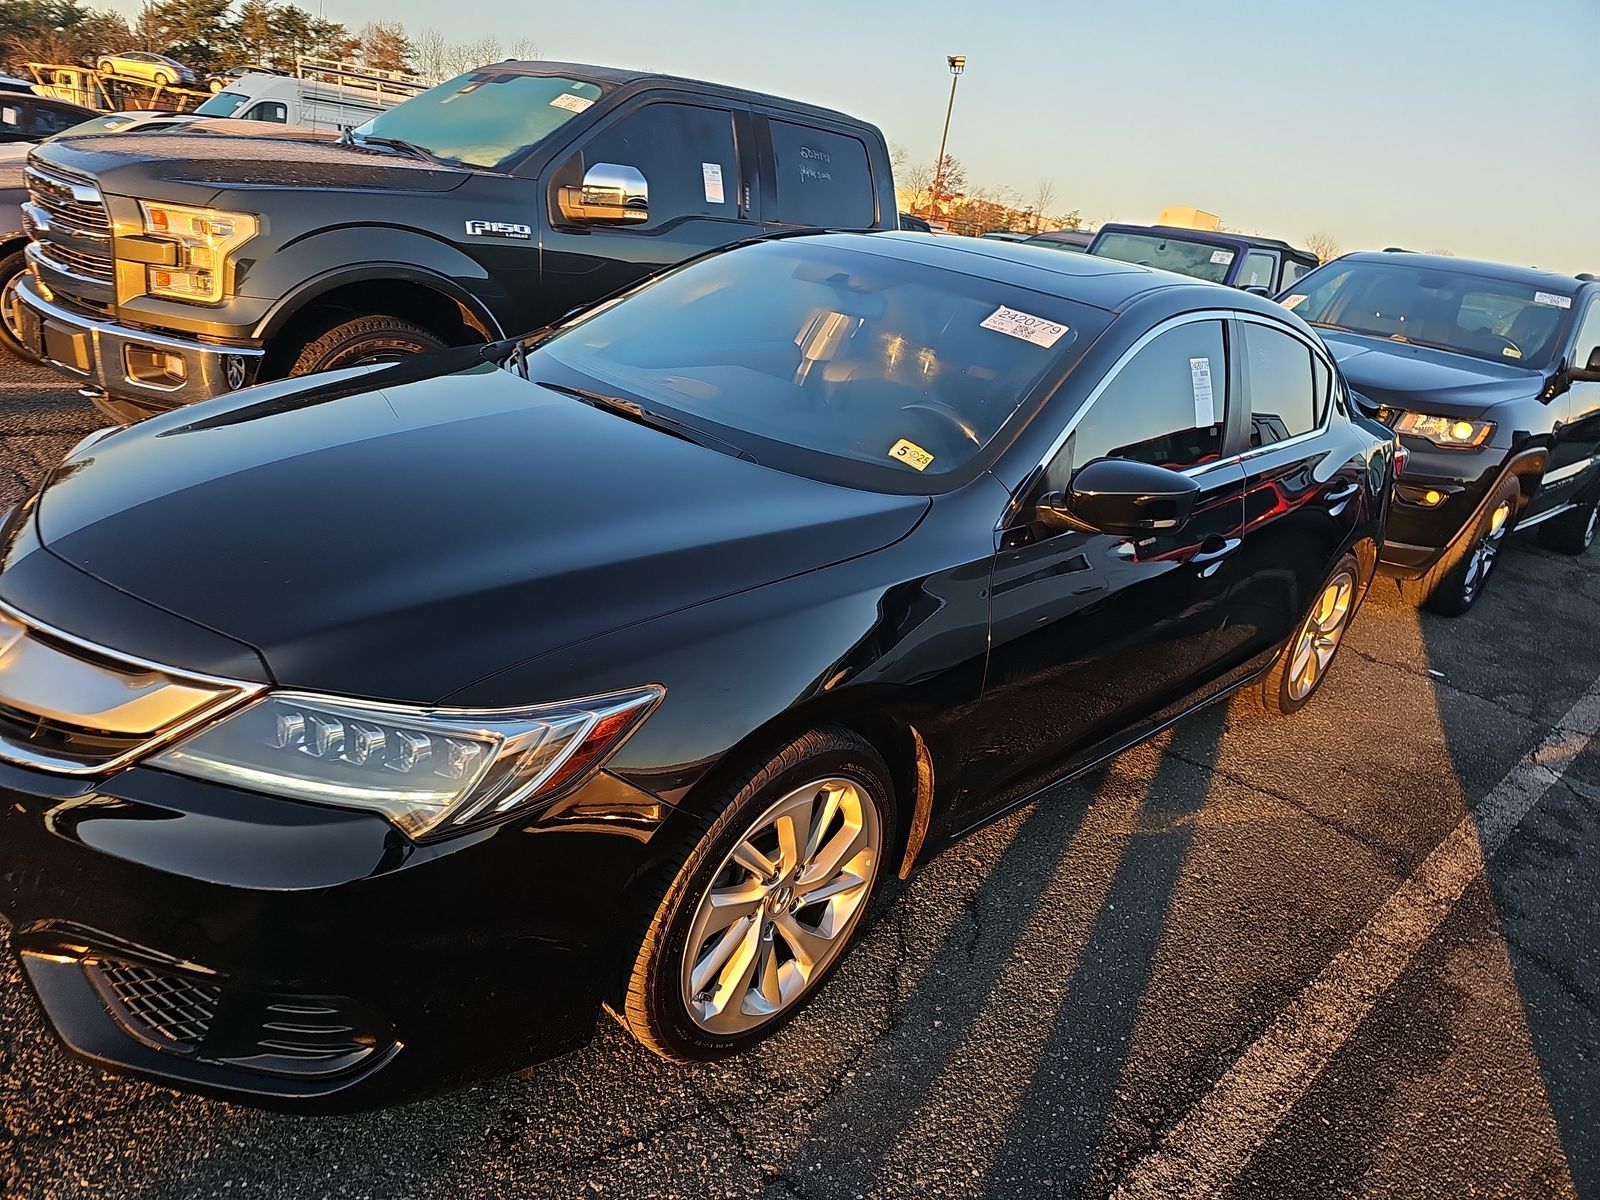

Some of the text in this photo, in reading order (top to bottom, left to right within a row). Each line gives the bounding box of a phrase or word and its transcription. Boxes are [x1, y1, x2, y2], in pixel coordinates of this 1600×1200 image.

[998, 309, 1062, 335] 2420779
[896, 445, 931, 465] 5 25
